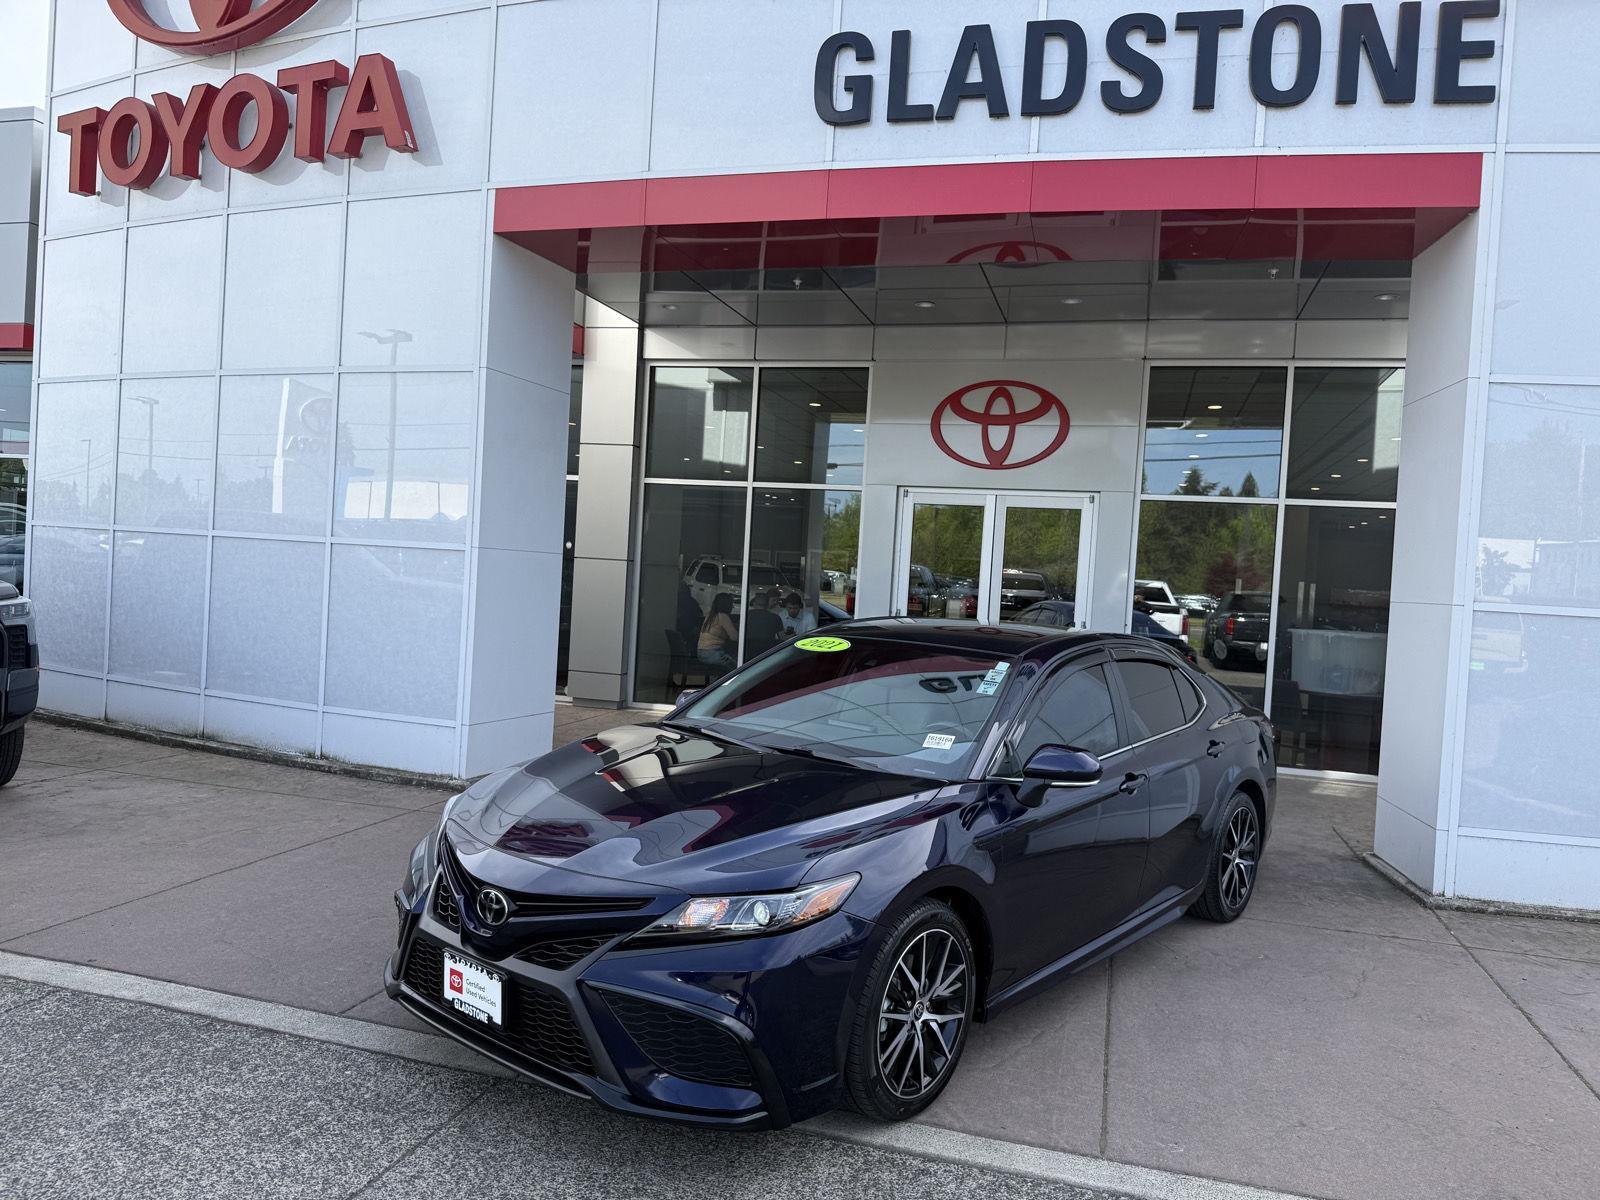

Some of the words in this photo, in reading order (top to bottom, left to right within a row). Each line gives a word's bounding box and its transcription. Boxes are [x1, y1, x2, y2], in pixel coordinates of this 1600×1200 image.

[814, 1, 1501, 125] GLADSTONE
[58, 53, 418, 197] TOYOTA
[801, 639, 843, 650] 2021
[466, 978, 486, 992] Certified
[466, 987, 477, 998] Used
[477, 992, 497, 1007] Vehicles
[454, 999, 489, 1023] GLADSTONE
